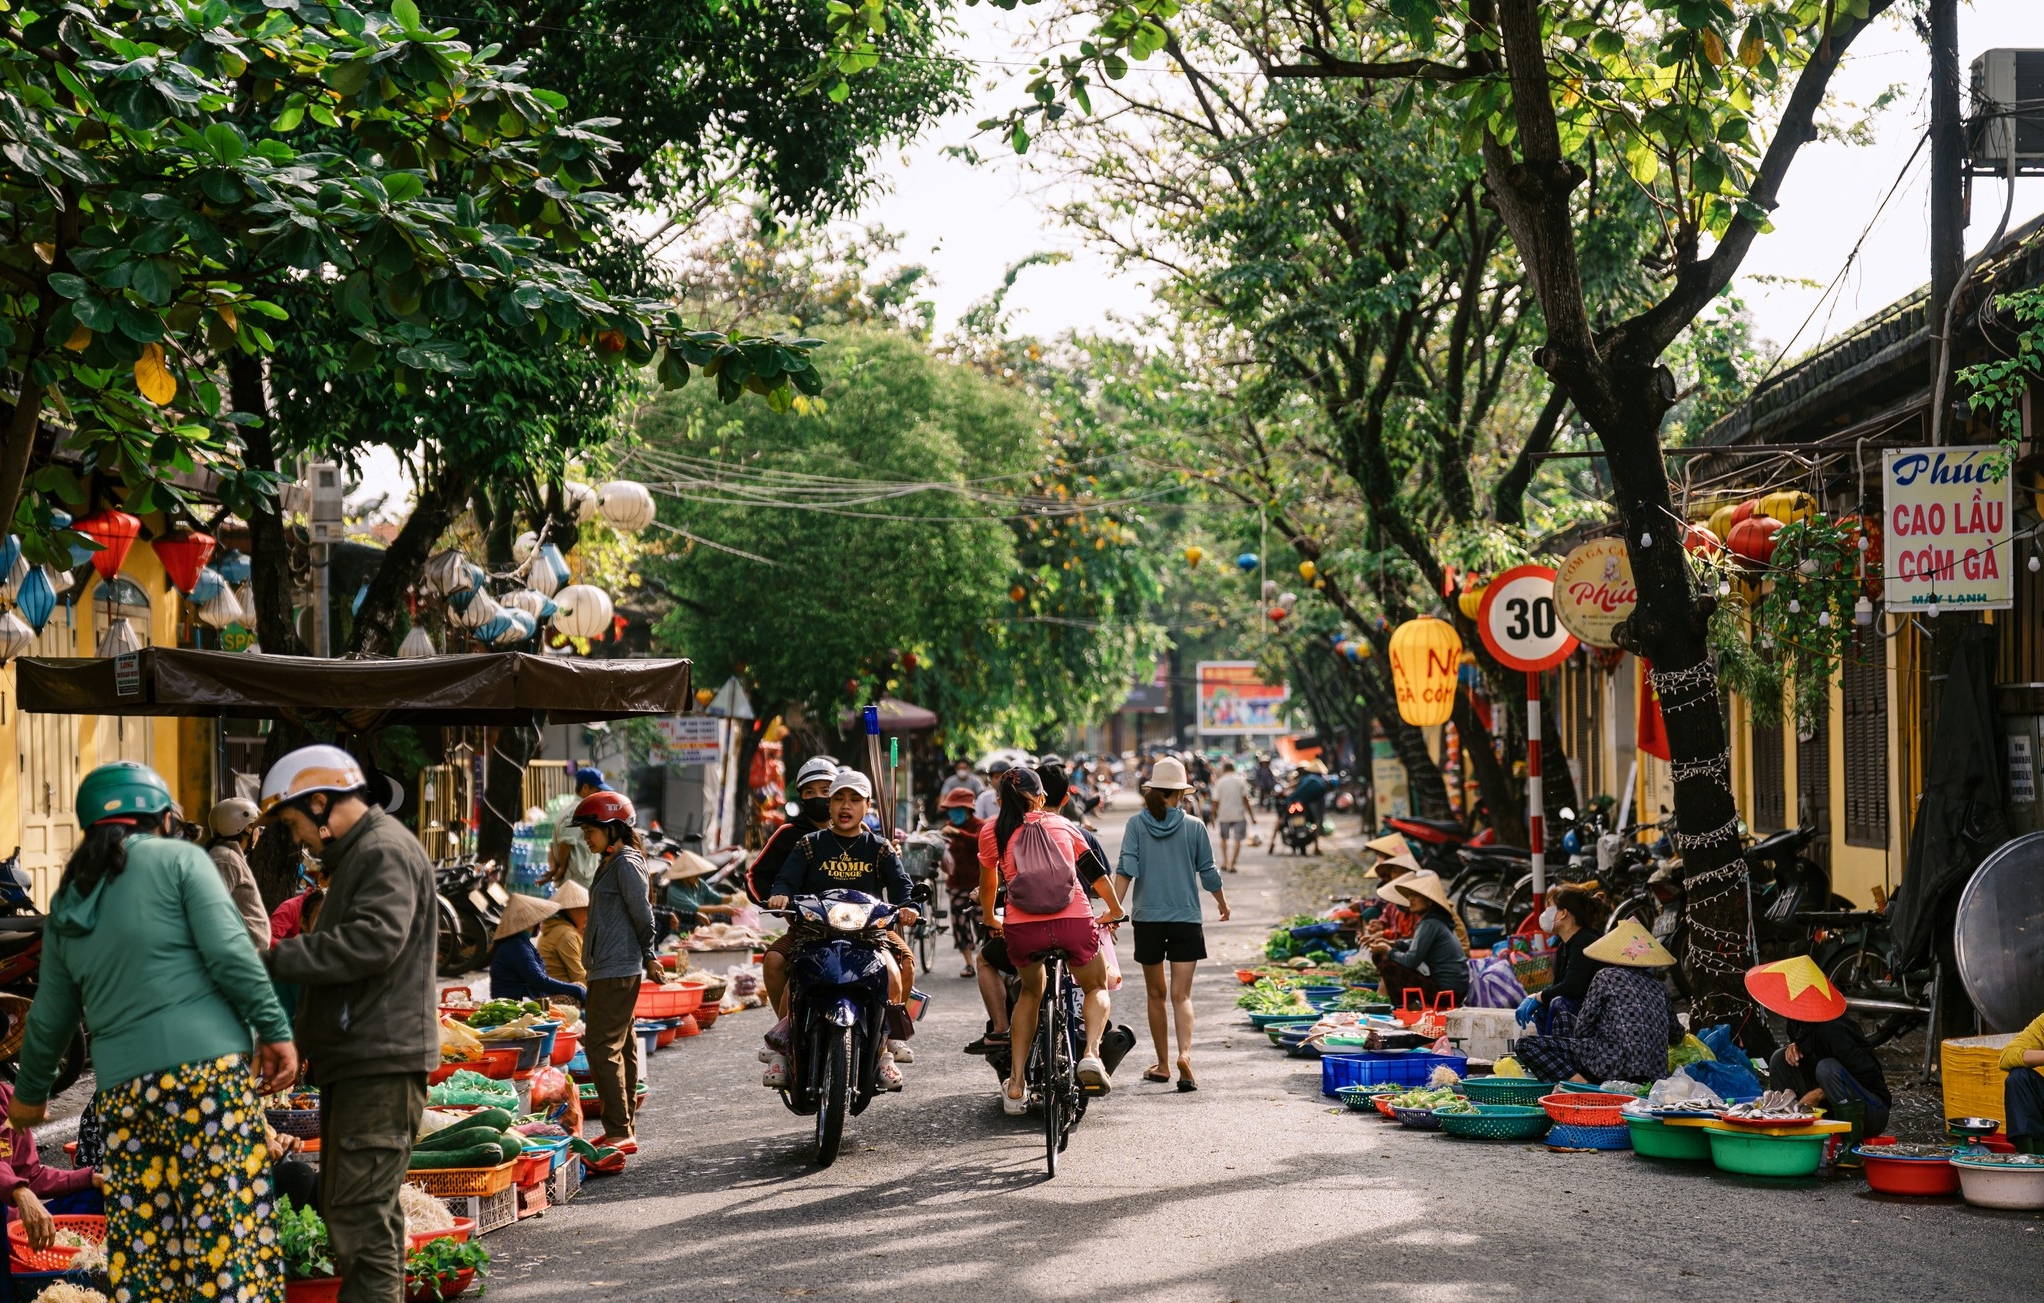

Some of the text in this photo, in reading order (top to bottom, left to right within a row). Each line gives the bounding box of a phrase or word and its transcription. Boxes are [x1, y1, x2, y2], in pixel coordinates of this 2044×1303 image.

[1892, 451, 1993, 486] Phúc
[1892, 488, 2003, 537] CAO LẦU
[1608, 545, 1629, 559] CA
[1898, 539, 1999, 583] CƠM GÀ
[1569, 580, 1636, 613] Phúc
[1505, 597, 1557, 641] 30
[224, 633, 255, 650] SPA
[818, 860, 873, 873] ATOMIC
[828, 870, 862, 878] LOUNGE
